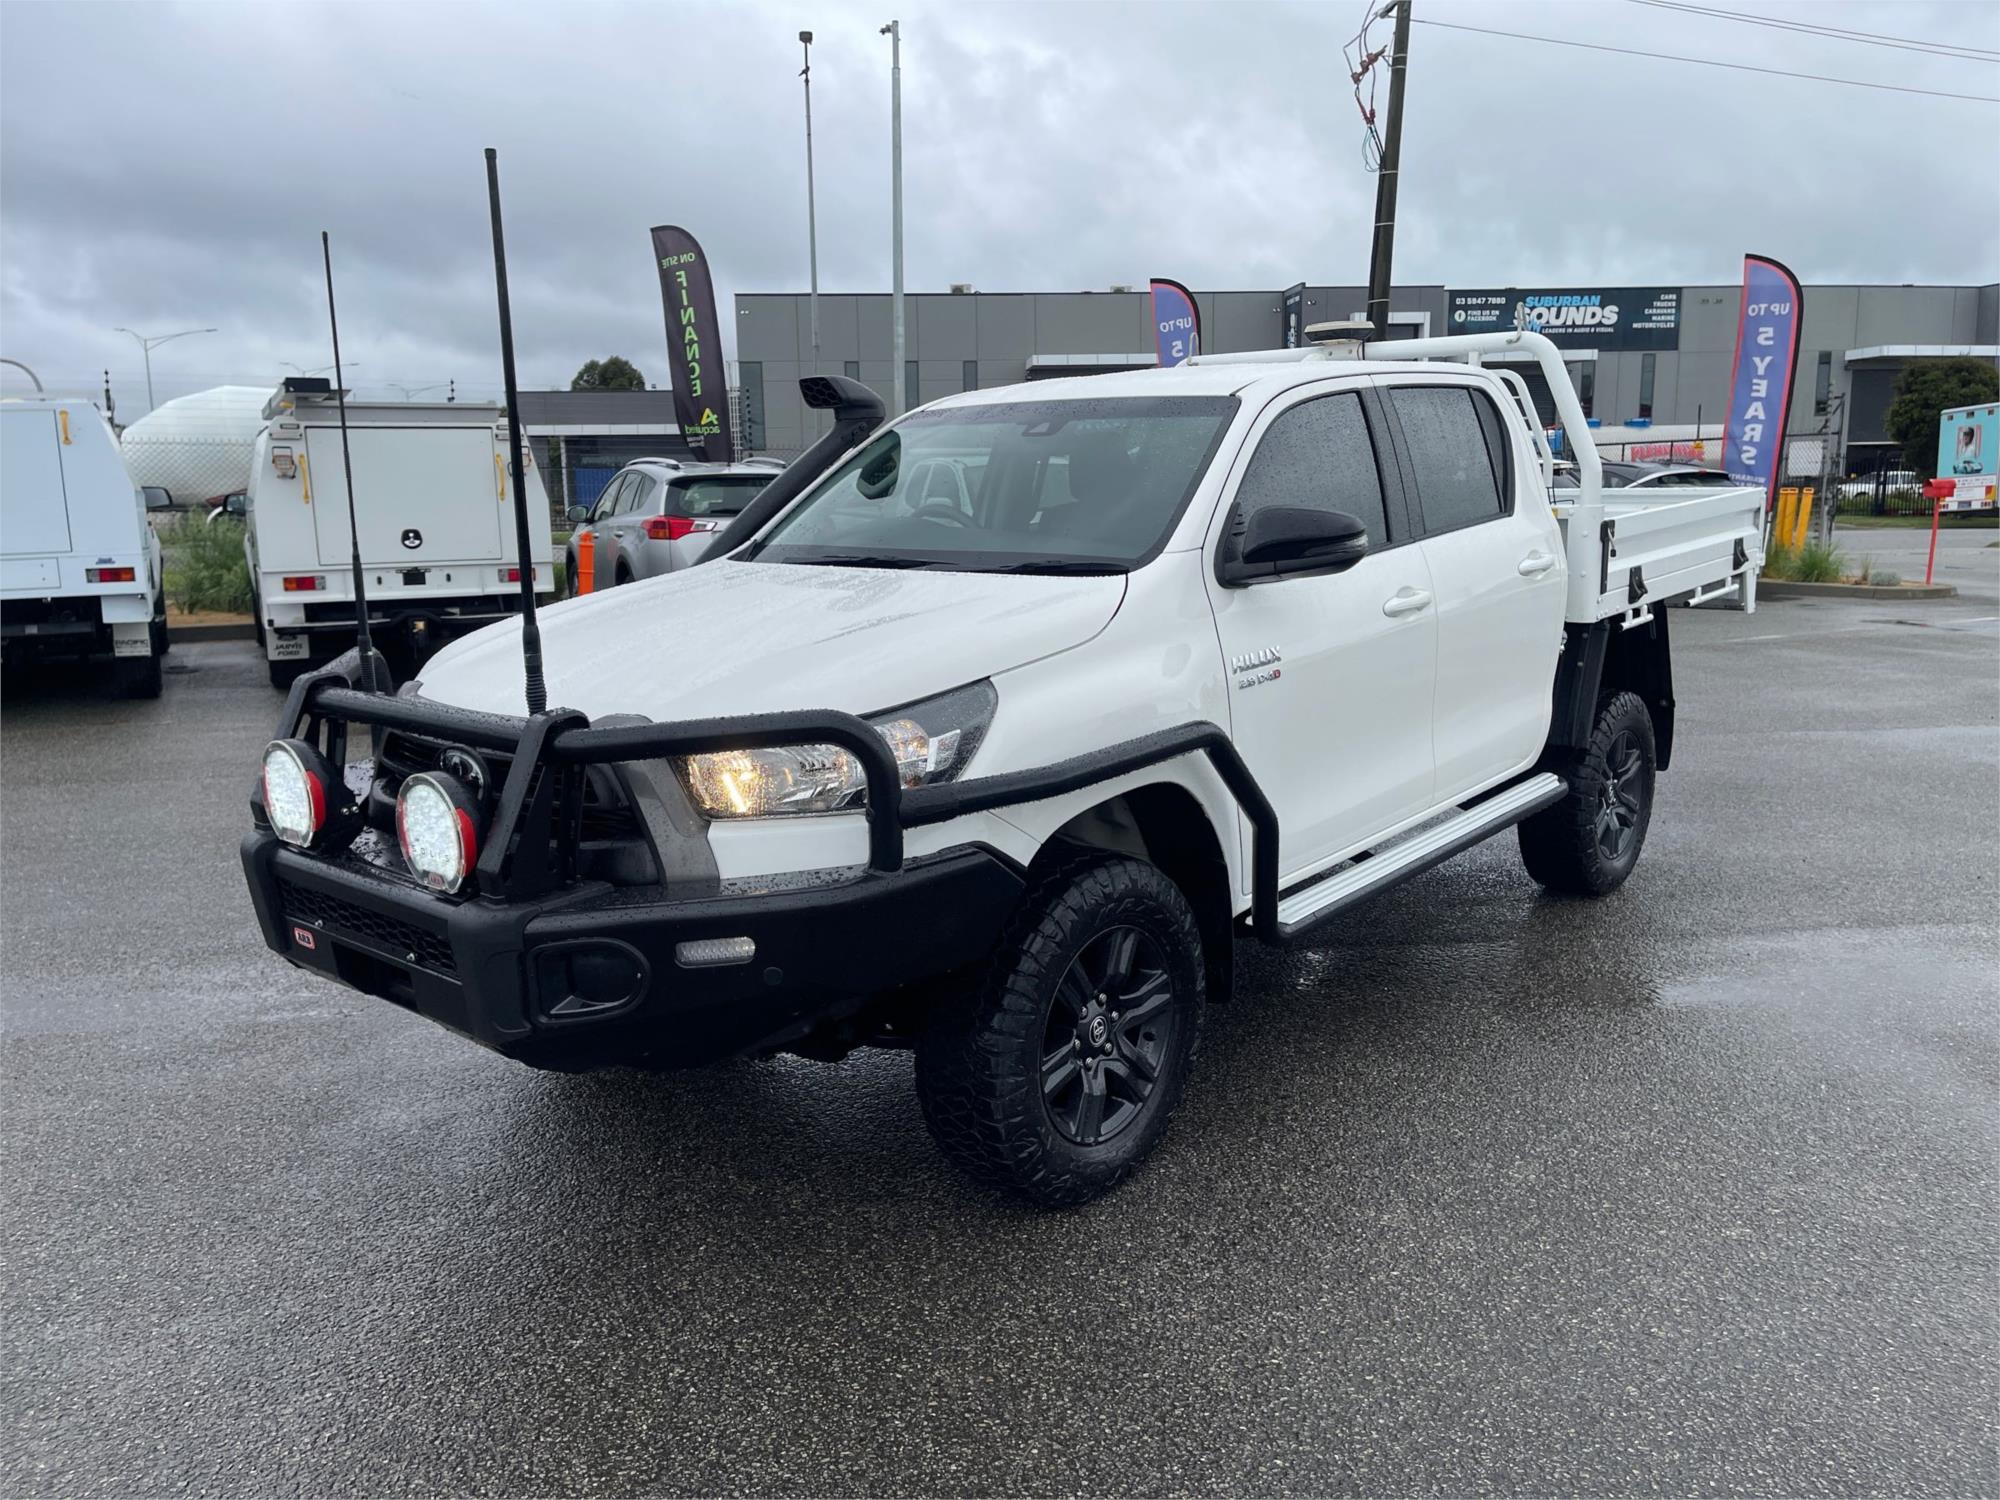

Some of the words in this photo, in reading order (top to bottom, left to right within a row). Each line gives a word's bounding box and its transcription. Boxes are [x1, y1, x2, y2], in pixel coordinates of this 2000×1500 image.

[1525, 295, 1600, 307] SUBURBAN
[1513, 305, 1619, 326] SOUNDS
[1231, 645, 1282, 675] HILUX
